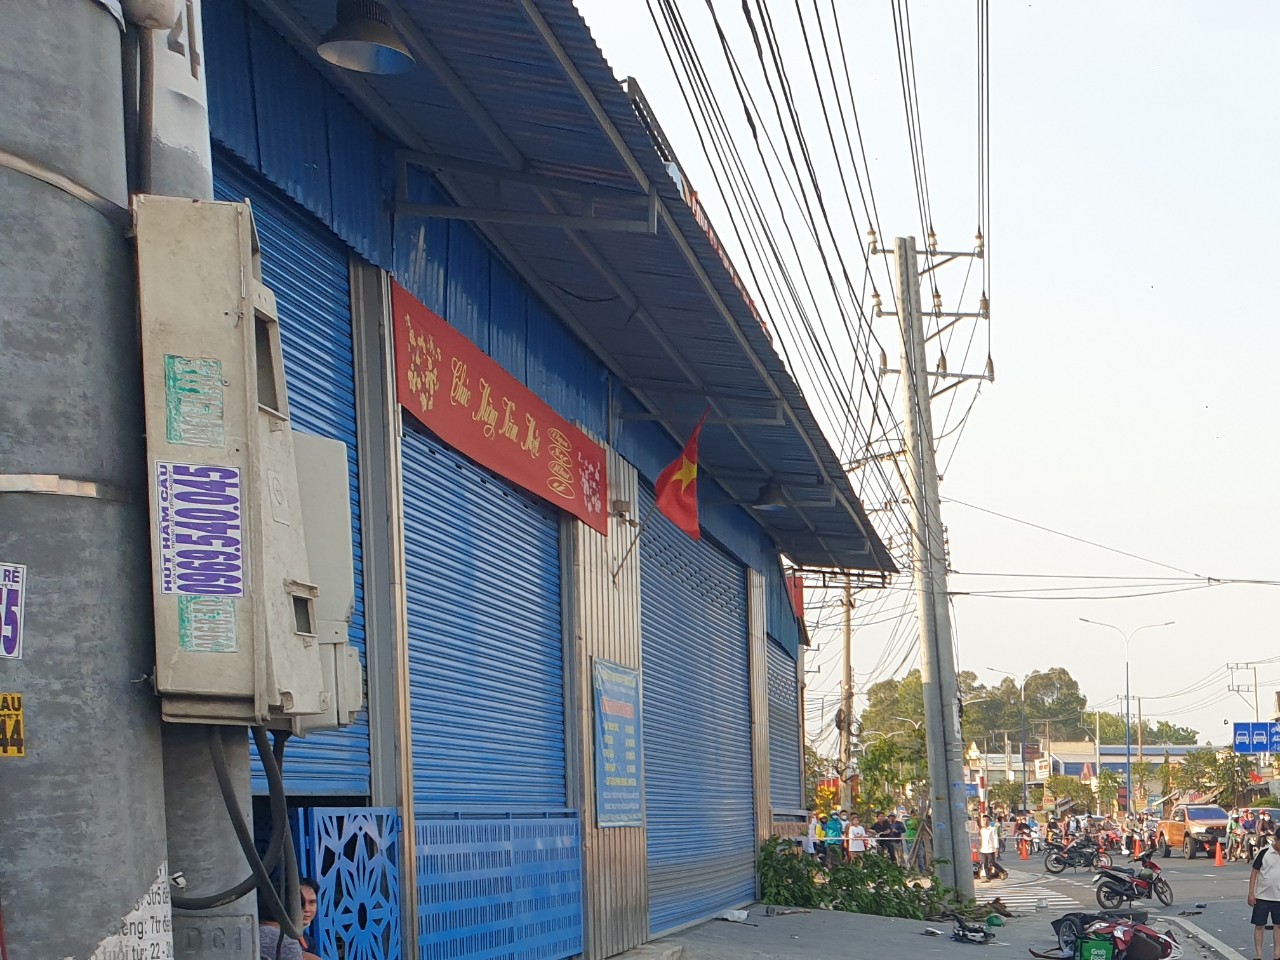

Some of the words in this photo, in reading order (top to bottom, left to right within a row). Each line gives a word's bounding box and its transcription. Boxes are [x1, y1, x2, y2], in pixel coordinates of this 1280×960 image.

[158, 464, 170, 503] CẦU
[158, 507, 171, 549] HẦM
[172, 465, 242, 594] 0969.540.045
[161, 554, 173, 592] HÚT
[150, 942, 160, 960] 22
[1091, 948, 1107, 956] Grab
